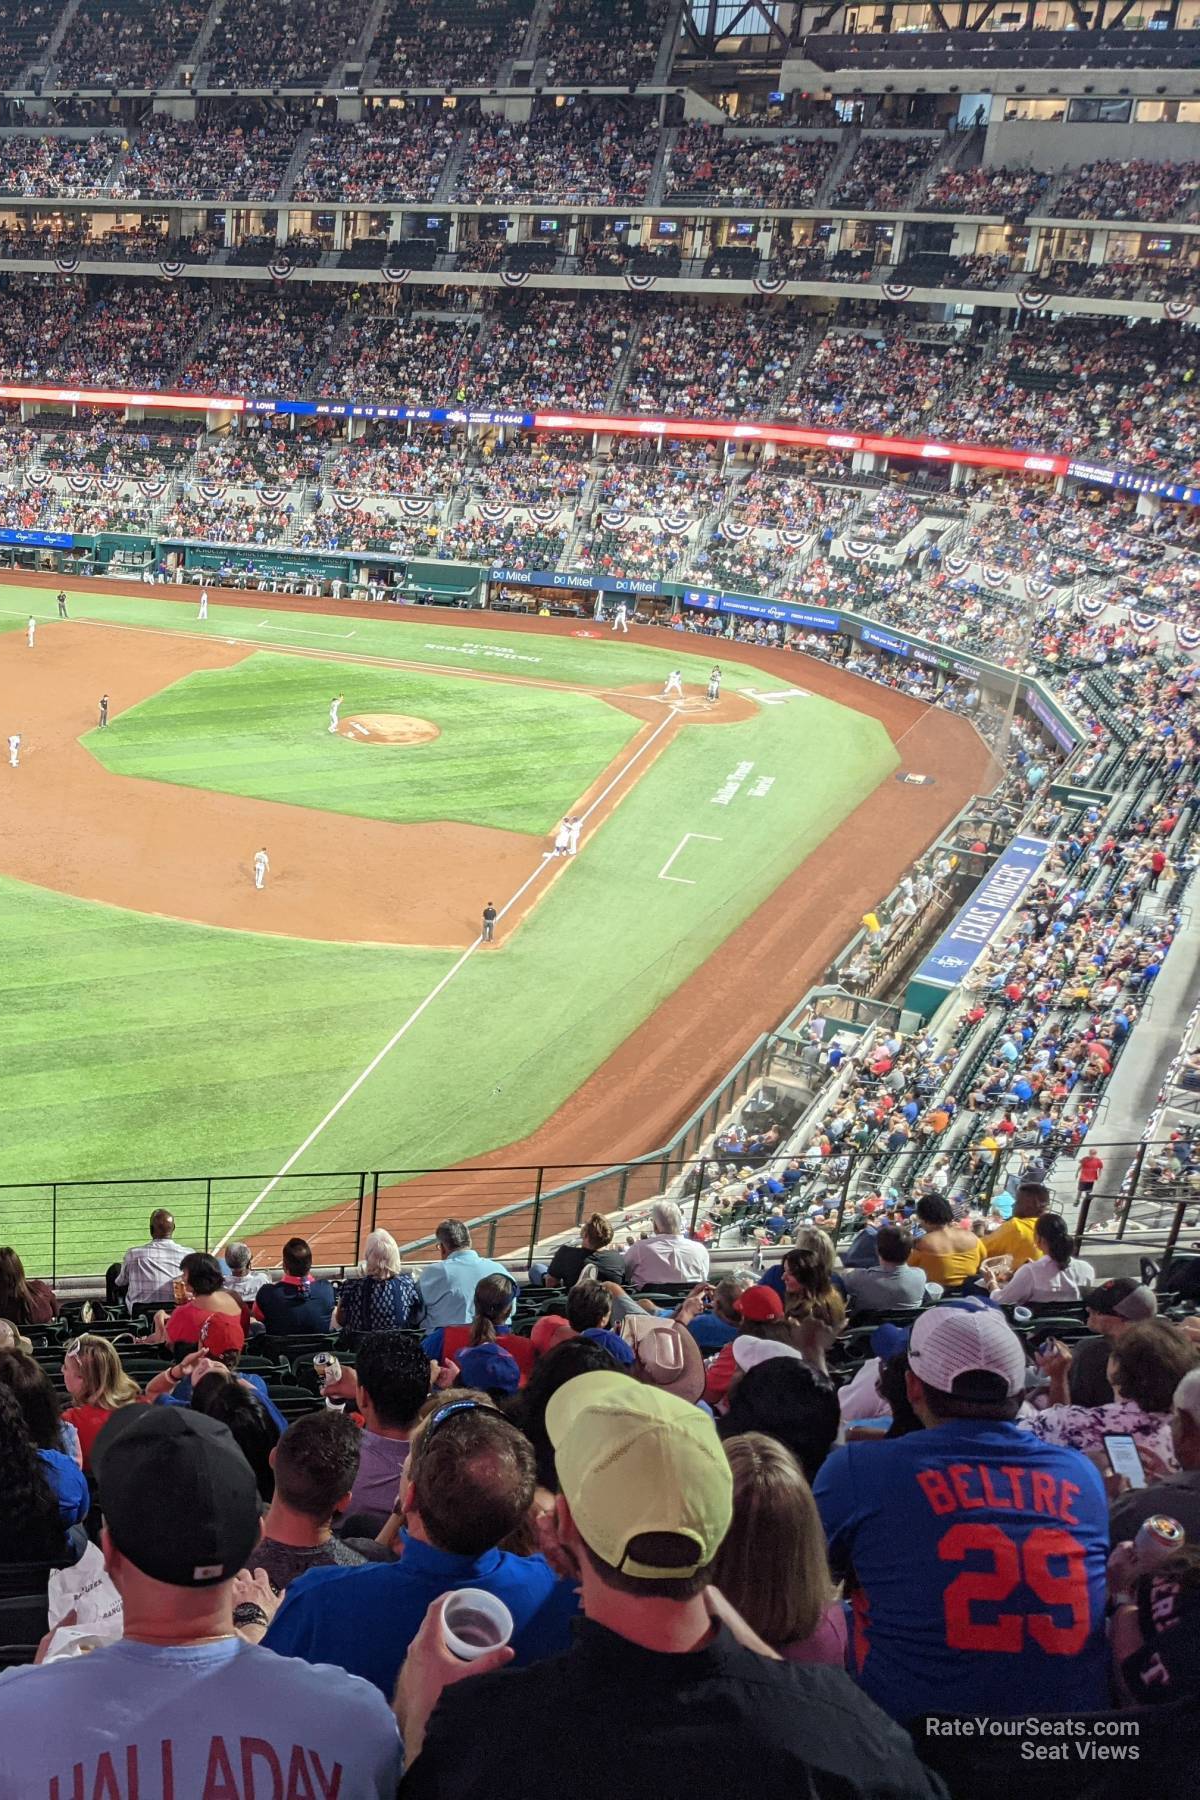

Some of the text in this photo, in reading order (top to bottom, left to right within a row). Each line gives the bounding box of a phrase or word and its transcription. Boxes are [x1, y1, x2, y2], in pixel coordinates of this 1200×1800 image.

[506, 571, 532, 582] Mitel
[567, 576, 593, 587] Mitel
[629, 581, 657, 592] Mitel
[950, 907, 1001, 943] TEXAS
[976, 864, 1031, 909] RANGERS
[916, 1463, 1080, 1526] BELTRE
[937, 1523, 1090, 1656] 29
